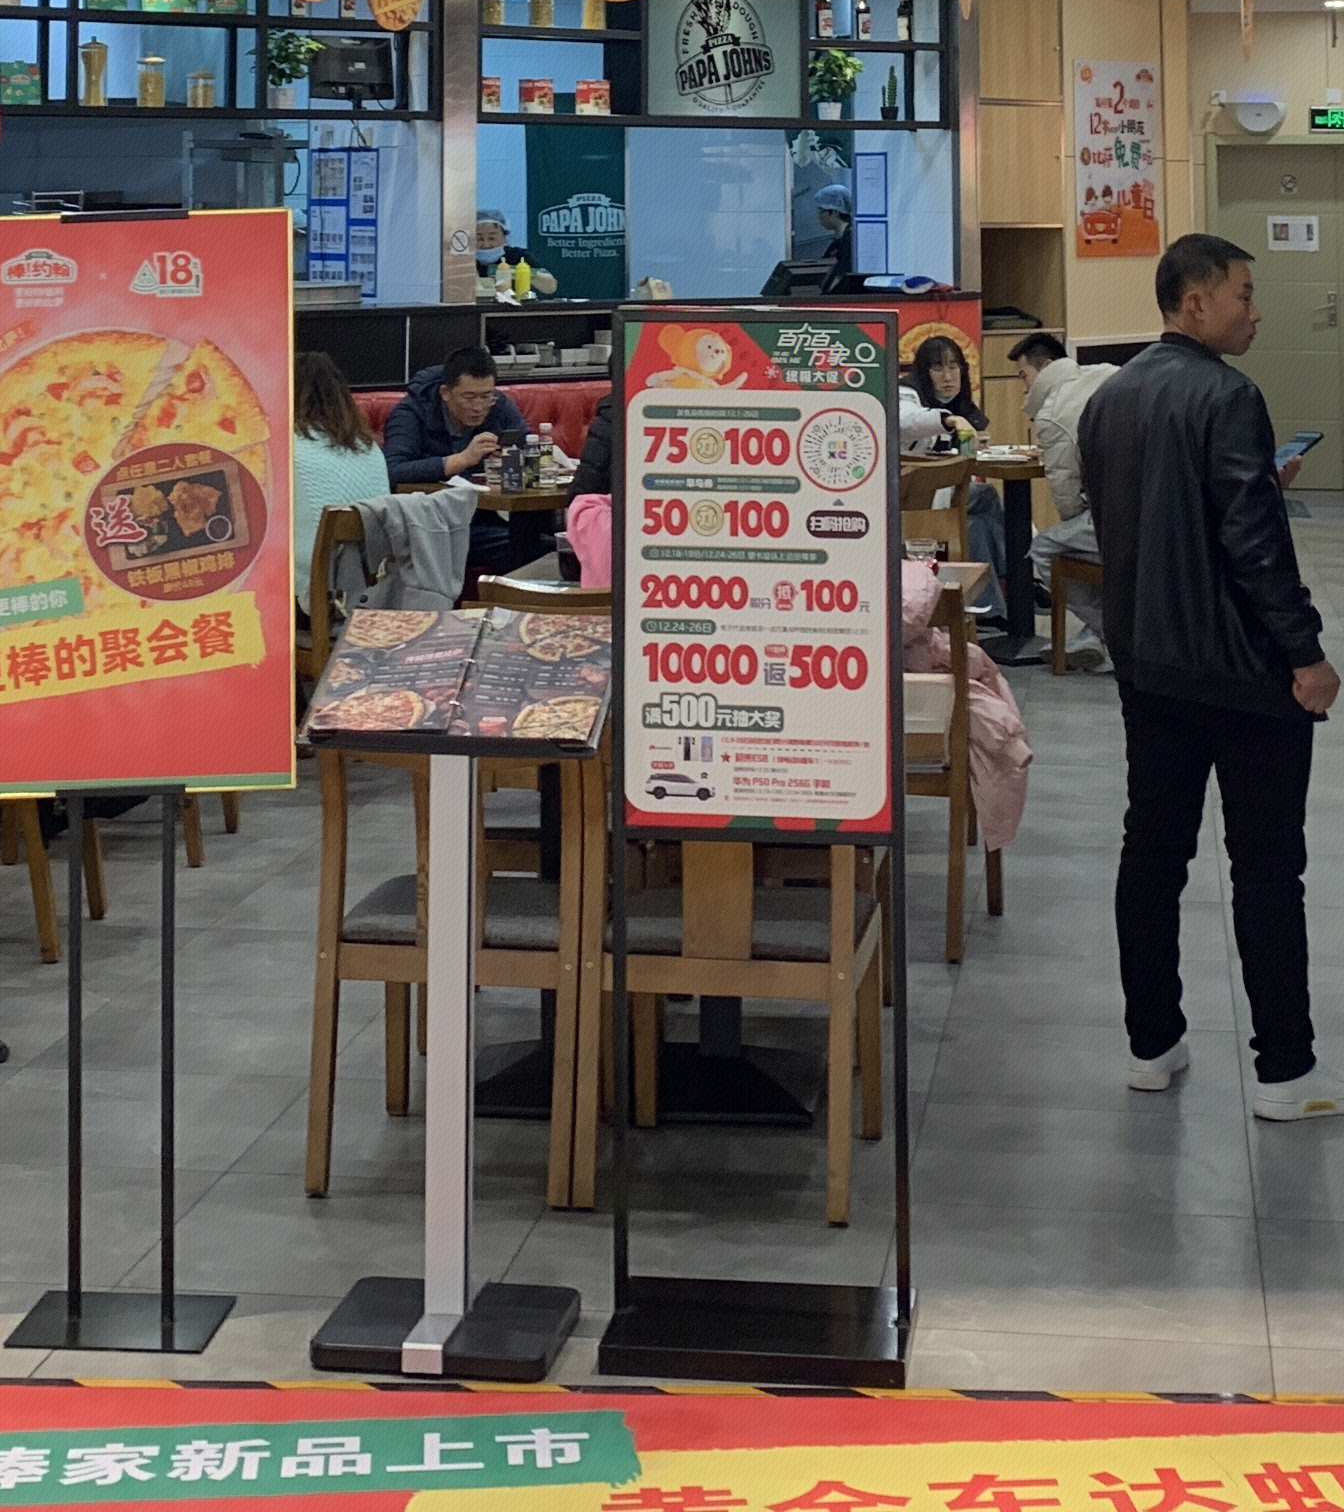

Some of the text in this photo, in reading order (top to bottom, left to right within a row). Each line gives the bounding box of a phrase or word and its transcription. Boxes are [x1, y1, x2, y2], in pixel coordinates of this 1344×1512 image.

[682, 11, 697, 55] FRESH
[733, 1, 759, 40] DOUGH
[679, 47, 772, 91] PAPA JOHNS
[542, 206, 625, 233] PAPA JOHN
[548, 237, 576, 247] Better
[561, 248, 591, 258] Better
[156, 254, 193, 285] 18
[643, 426, 689, 464] 75
[724, 427, 790, 466] 100
[90, 495, 147, 547] 送
[641, 498, 790, 538] 50 100
[640, 574, 749, 610] 20000
[800, 579, 858, 612] 100
[658, 622, 712, 633] 12.24-26日
[642, 642, 759, 685] 10000
[789, 644, 868, 690] 500
